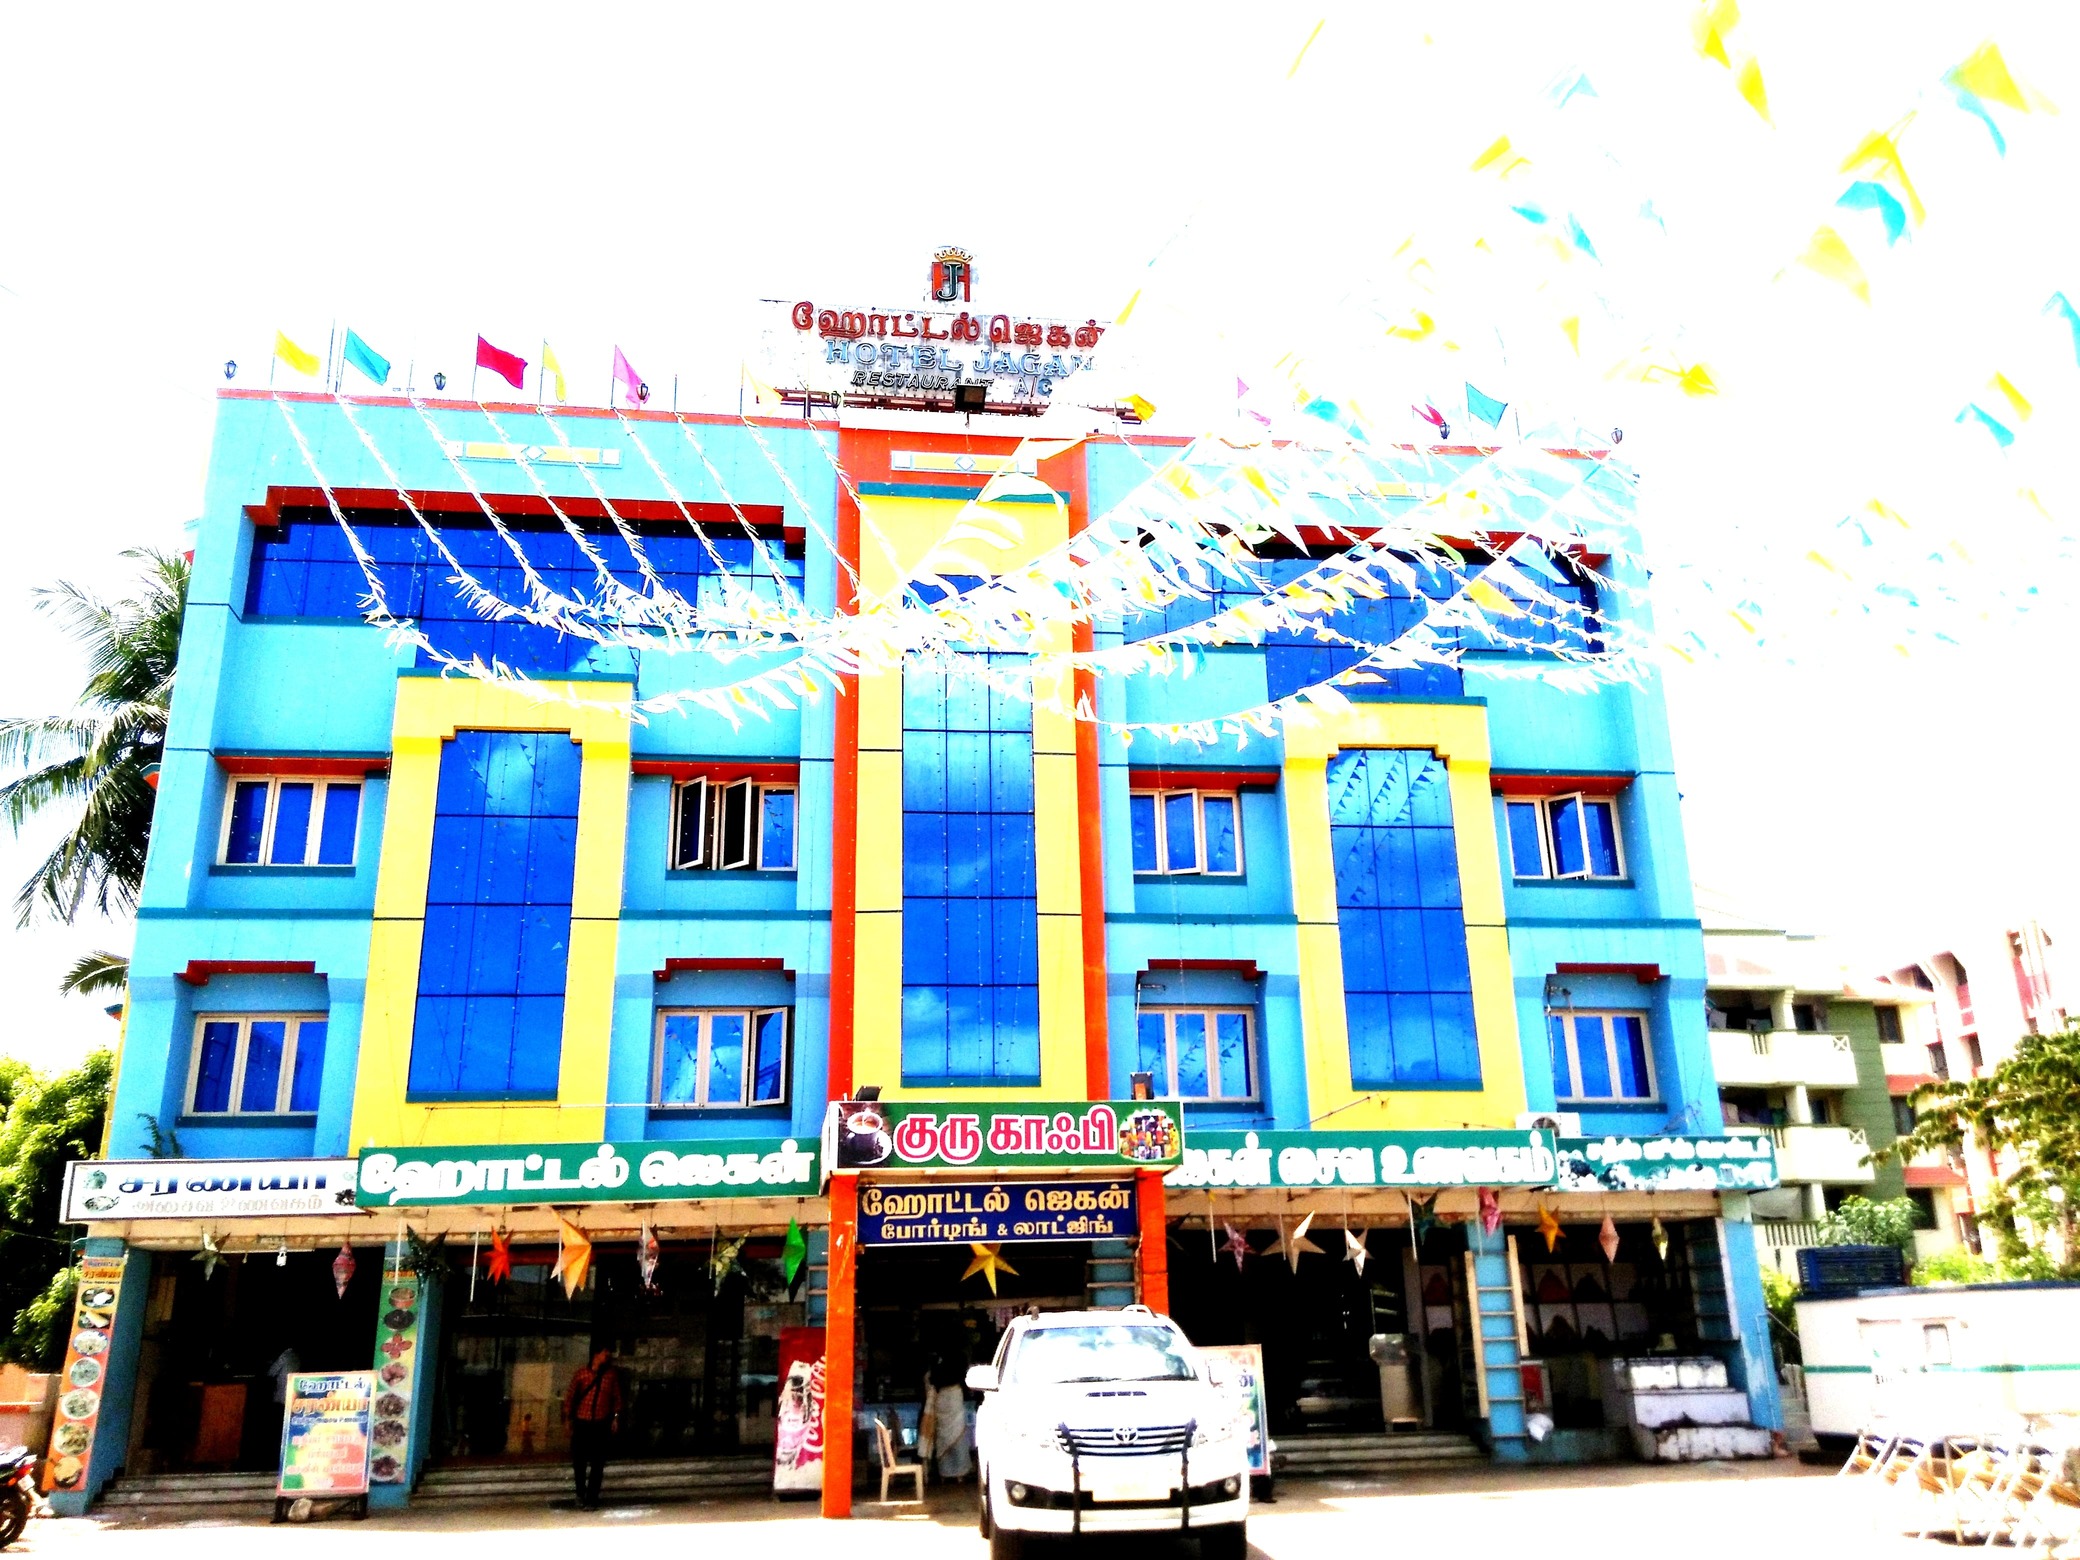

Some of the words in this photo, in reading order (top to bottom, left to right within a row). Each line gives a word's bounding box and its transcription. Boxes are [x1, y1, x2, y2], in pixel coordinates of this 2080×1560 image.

[792, 301, 981, 341] ஹோட்டல்
[989, 314, 1105, 348] ஜெகன்
[825, 339, 963, 371] HOTEL
[973, 349, 1097, 377] JAGAN
[1013, 375, 1053, 398] A/C
[895, 1112, 981, 1163] குரு
[990, 1105, 1118, 1154] காஃபி
[358, 1143, 630, 1206] ஹோட்டல்
[639, 1138, 816, 1188] ஜெகன்
[1381, 1130, 1555, 1185] உணவகம்
[861, 1186, 1010, 1222] ஹோட்டல்
[1025, 1183, 1131, 1212] ஜெகன்
[880, 1217, 988, 1241] போர்டிங்
[996, 1225, 1009, 1237] &
[1013, 1214, 1114, 1237] லாட்ஜிங்
